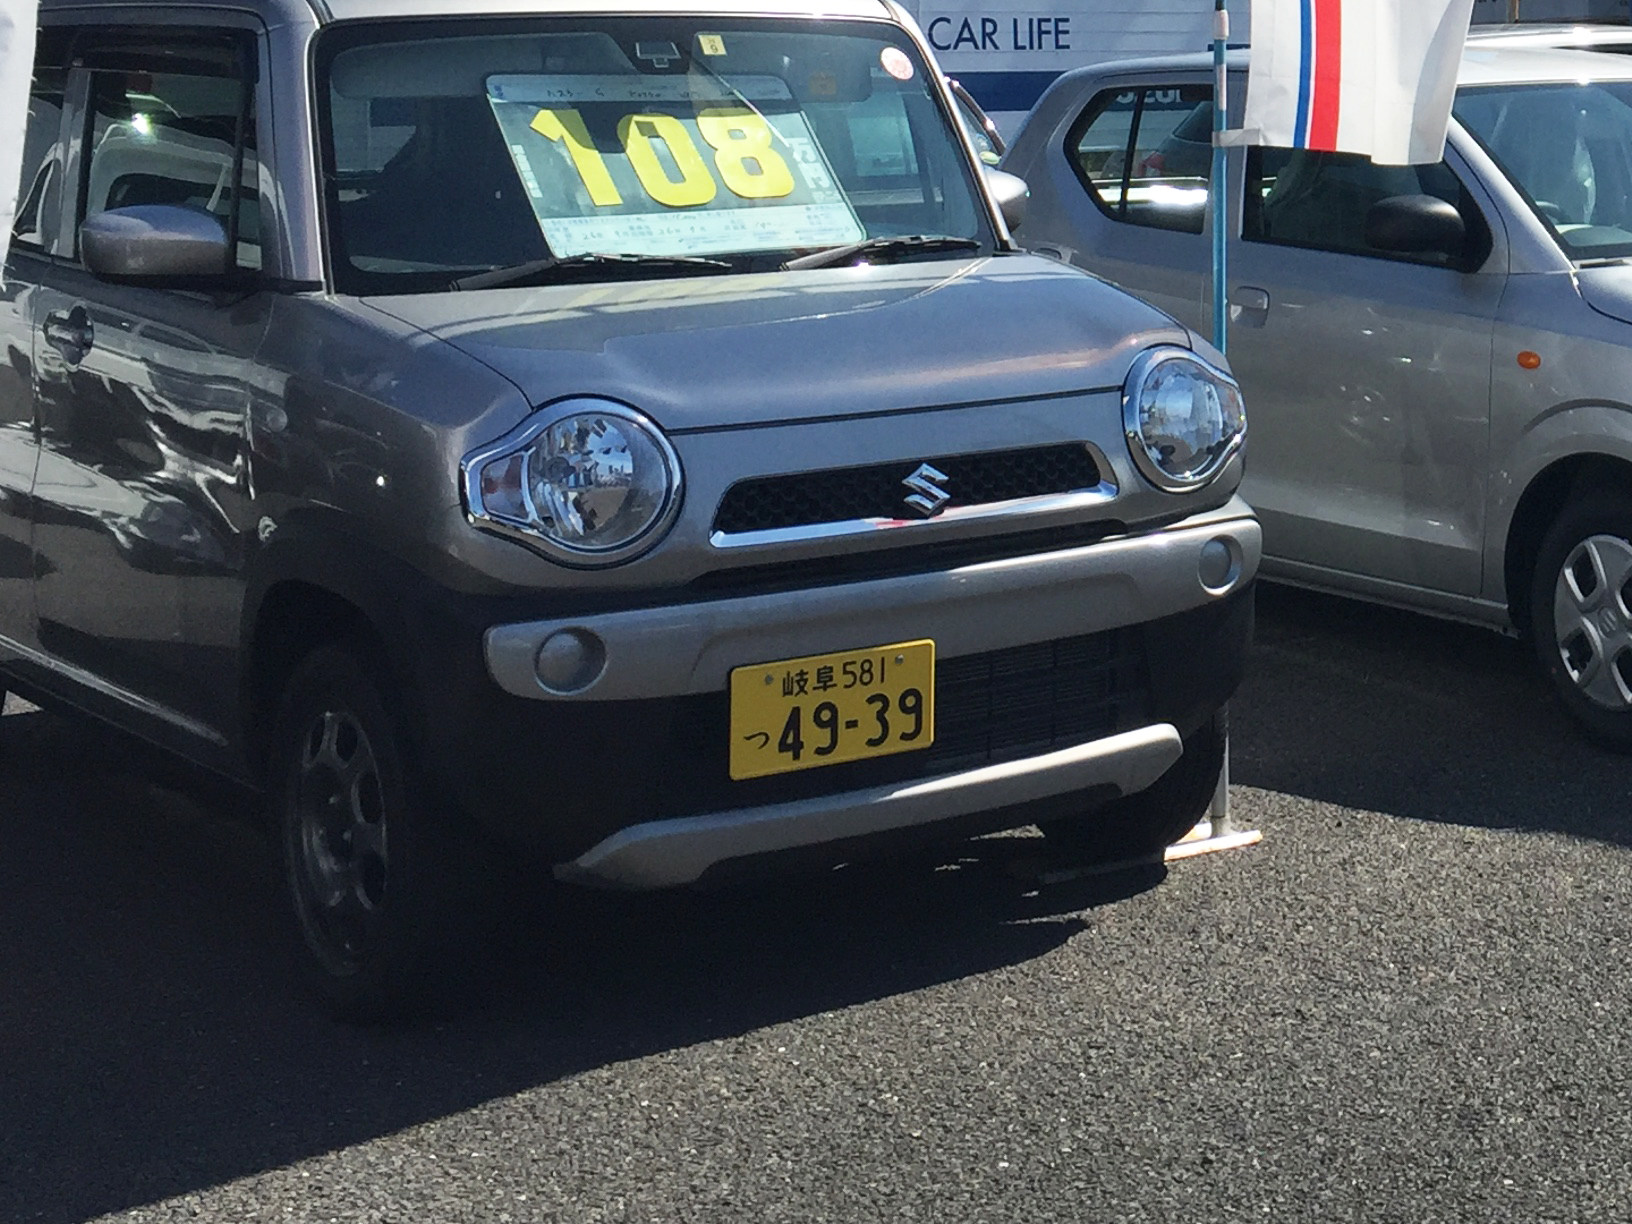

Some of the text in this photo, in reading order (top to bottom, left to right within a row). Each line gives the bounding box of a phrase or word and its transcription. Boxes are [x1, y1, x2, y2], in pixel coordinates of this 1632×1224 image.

[928, 16, 1071, 51] CAR LIFE
[530, 108, 795, 207] 108
[743, 687, 923, 761] つ 49-39
